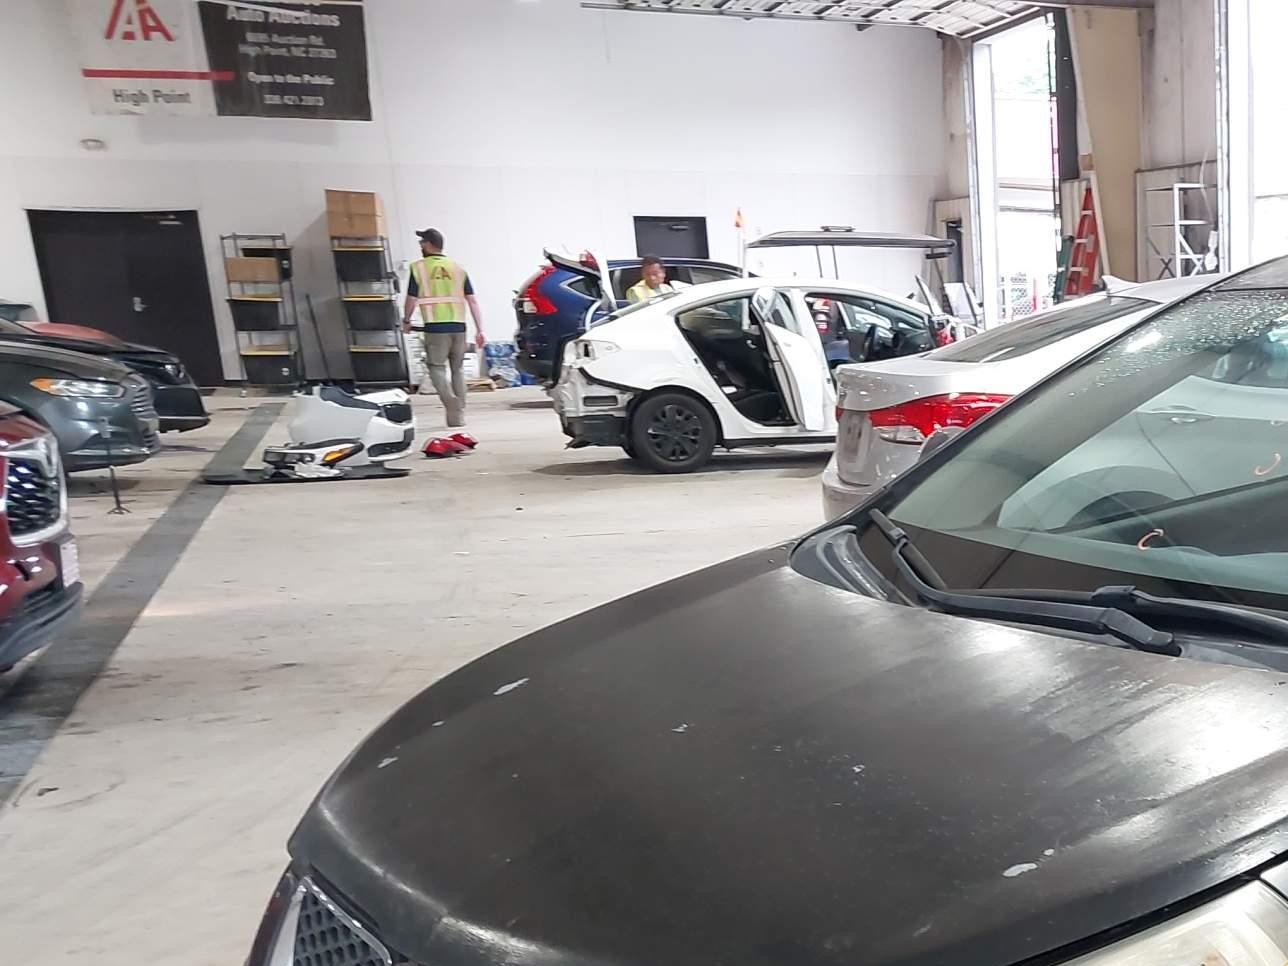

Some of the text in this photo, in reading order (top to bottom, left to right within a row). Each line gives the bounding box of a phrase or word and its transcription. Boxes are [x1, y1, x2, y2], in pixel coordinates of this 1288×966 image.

[247, 71, 273, 84] Open
[273, 74, 285, 83] to
[285, 74, 301, 83] the
[112, 89, 191, 106] High Point
